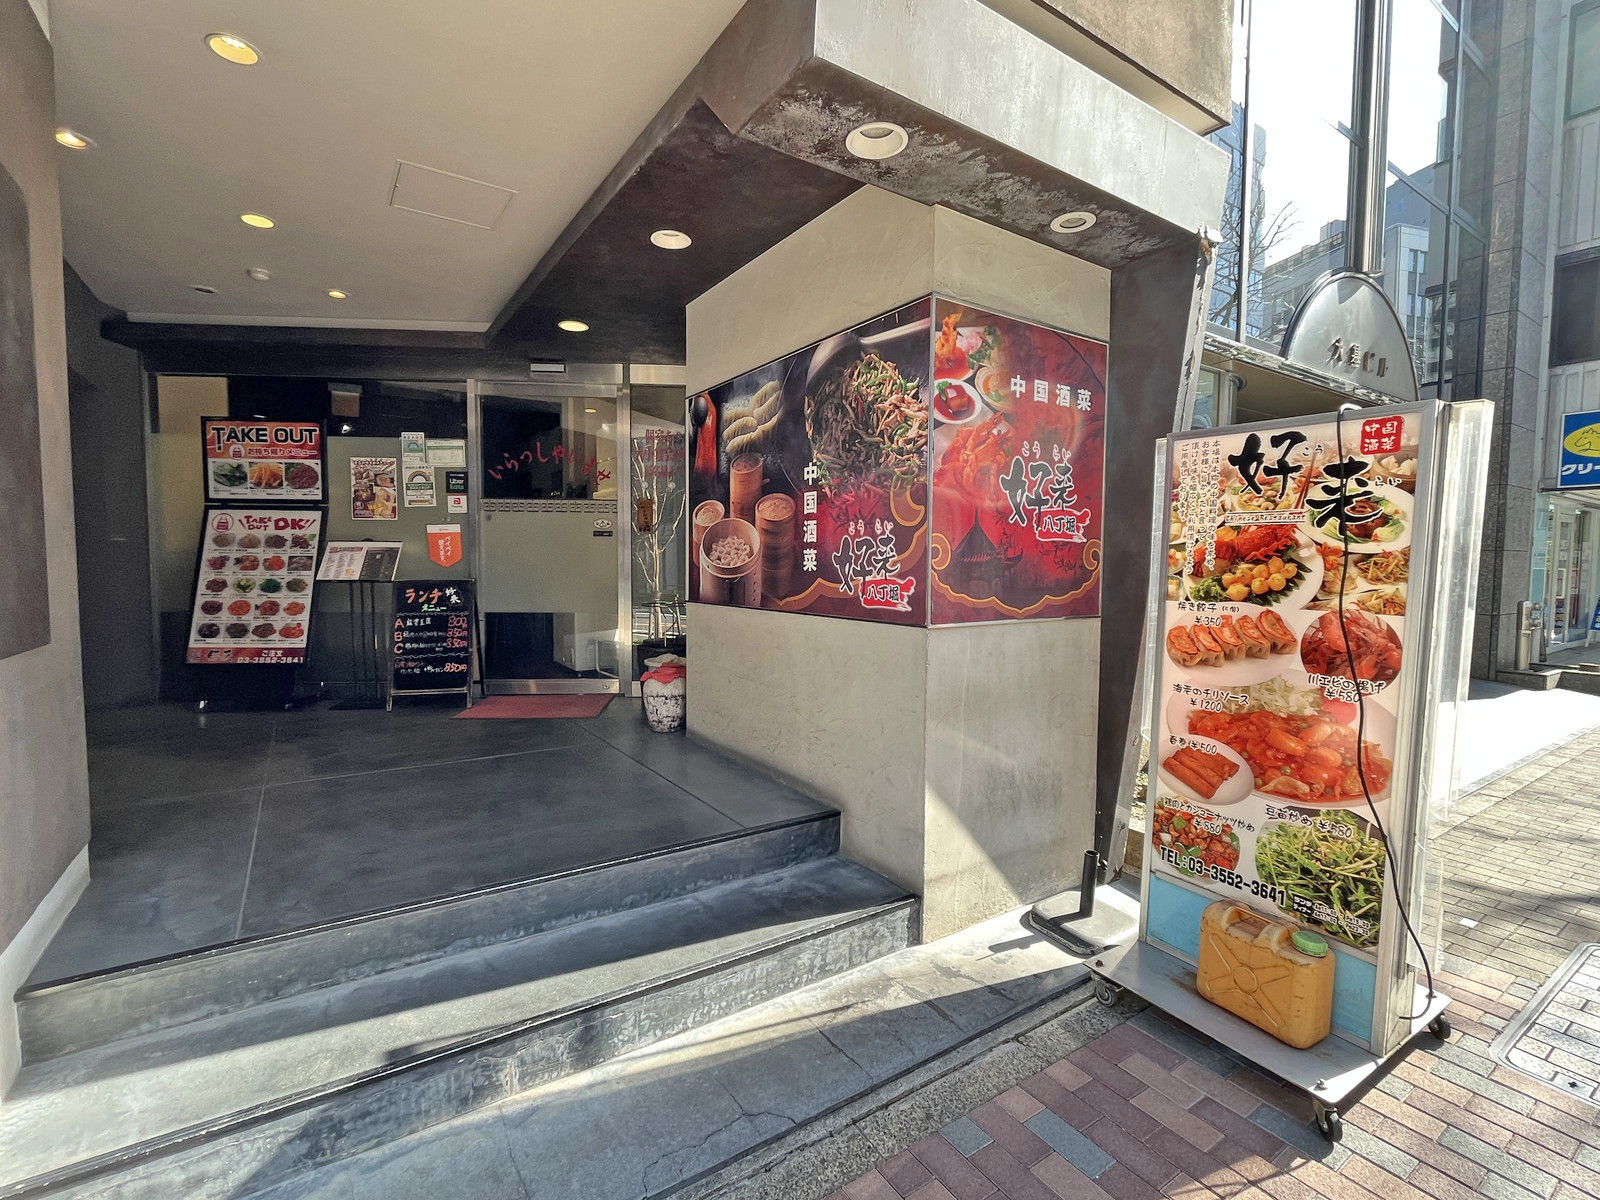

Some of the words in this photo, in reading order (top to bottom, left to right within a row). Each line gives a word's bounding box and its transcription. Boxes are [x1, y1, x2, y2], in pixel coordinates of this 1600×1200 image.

[1010, 375, 1092, 412] 中国酒菜
[1365, 421, 1398, 436] 中国
[211, 427, 268, 451] TAKE
[274, 428, 317, 443] OUT
[1364, 436, 1396, 451] 酒菜
[803, 462, 818, 572] 中国酒菜
[1043, 515, 1076, 533] 八丁堀
[1226, 514, 1255, 522] Chinese
[405, 588, 443, 604] ランチ
[867, 584, 900, 602] 八丁堀
[421, 604, 447, 612] メニュー
[1178, 601, 1217, 612] 焼き餃子
[395, 618, 404, 629] A
[394, 631, 403, 641] B
[394, 643, 404, 654] C
[1173, 683, 1249, 705] 海老のチリソース
